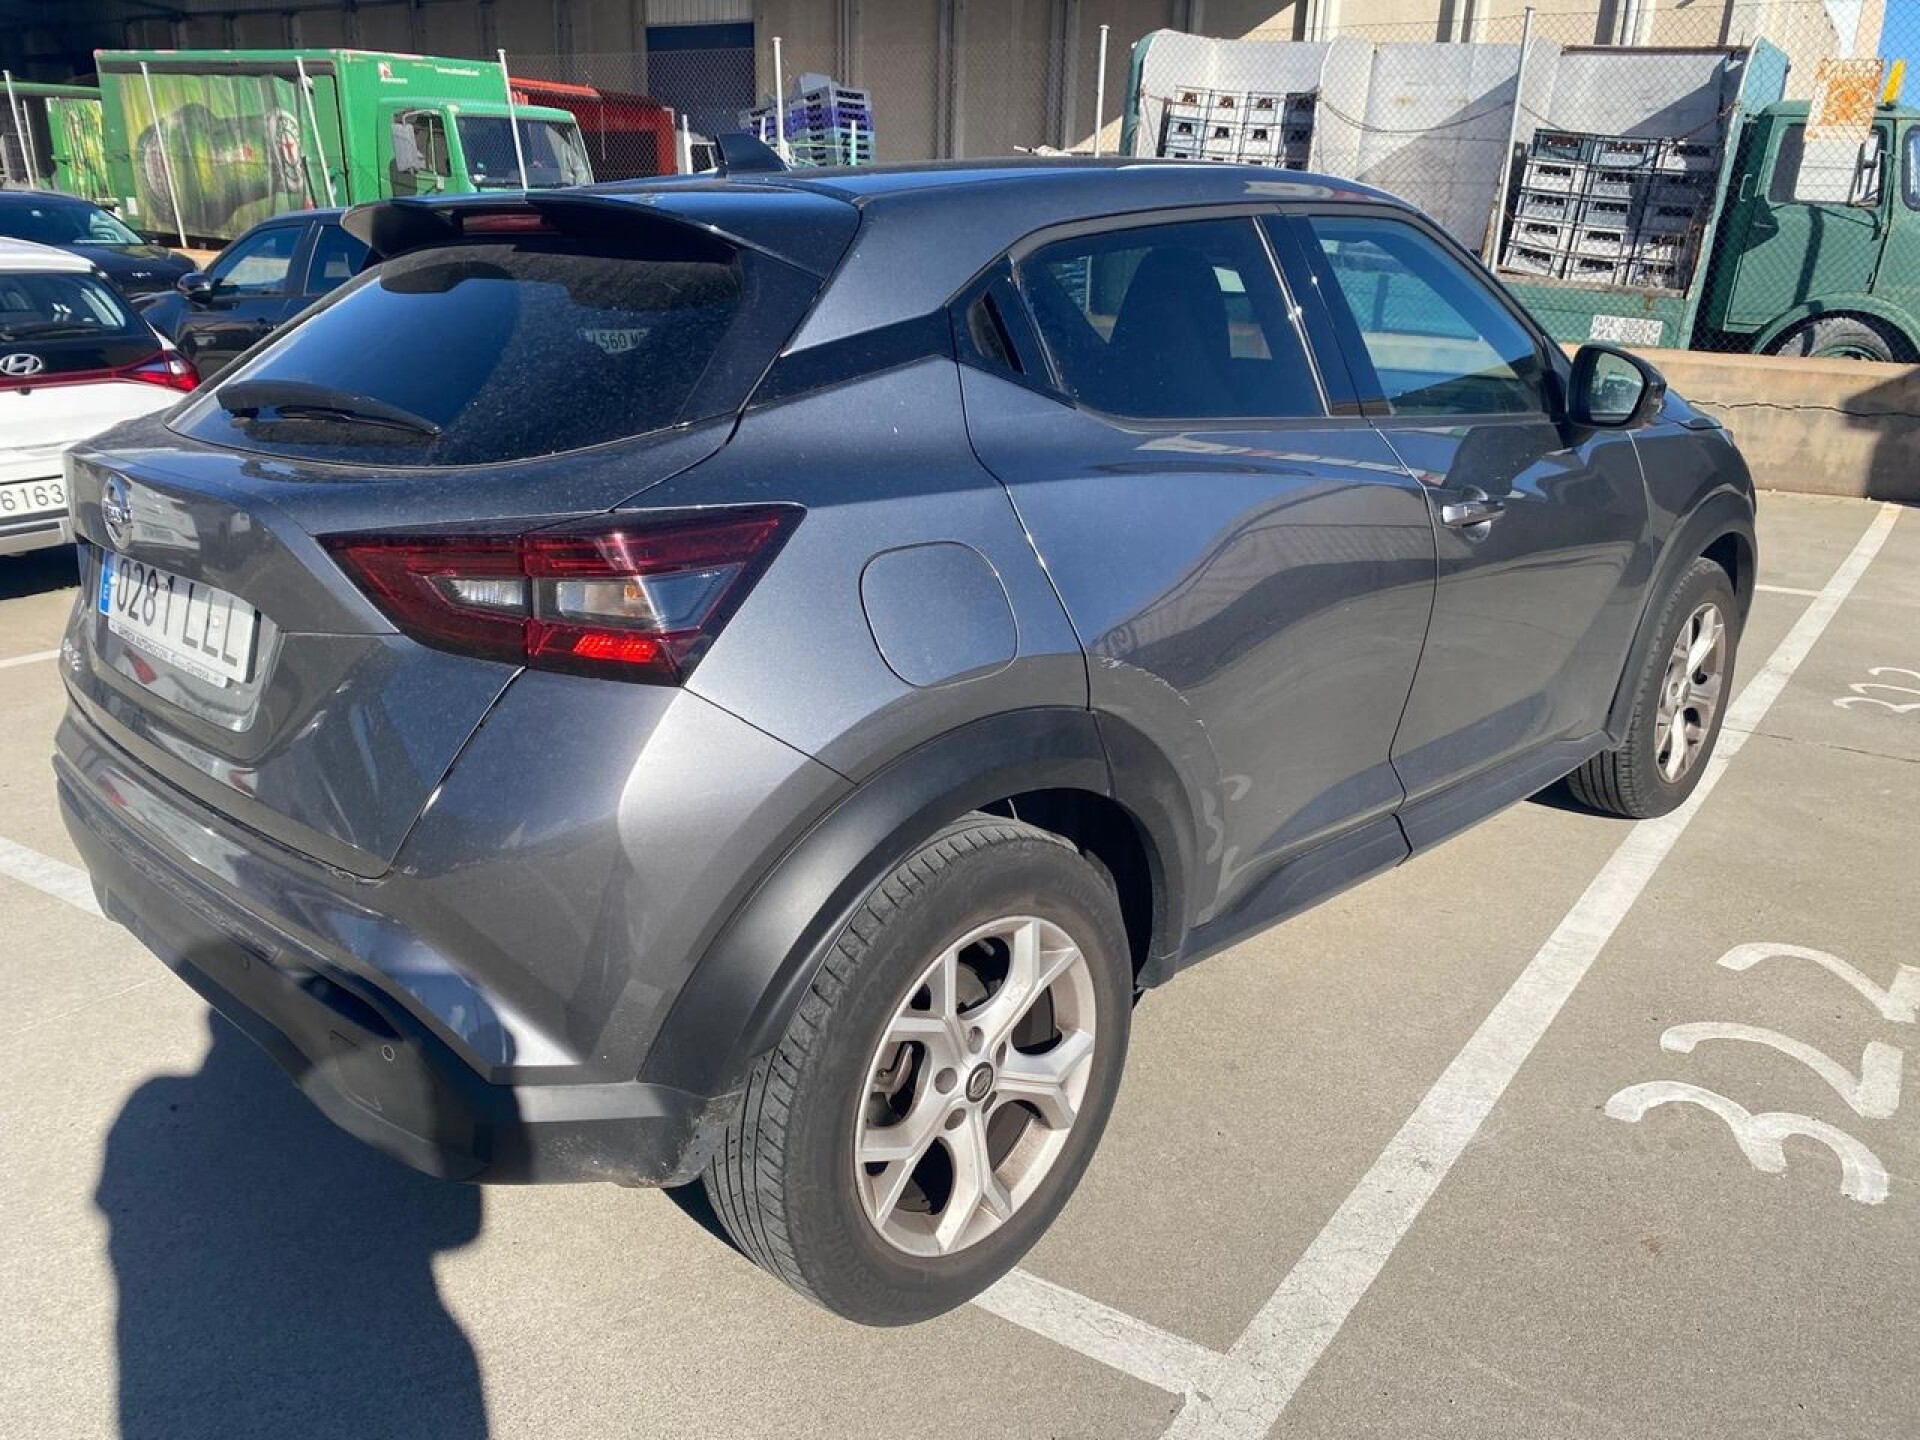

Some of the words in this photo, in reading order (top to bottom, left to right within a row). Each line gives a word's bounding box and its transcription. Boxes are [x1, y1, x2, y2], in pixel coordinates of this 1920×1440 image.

[1, 483, 66, 512] 6163
[115, 558, 175, 636] 0281
[183, 583, 238, 667] LLL
[1604, 942, 1920, 1205] 322
